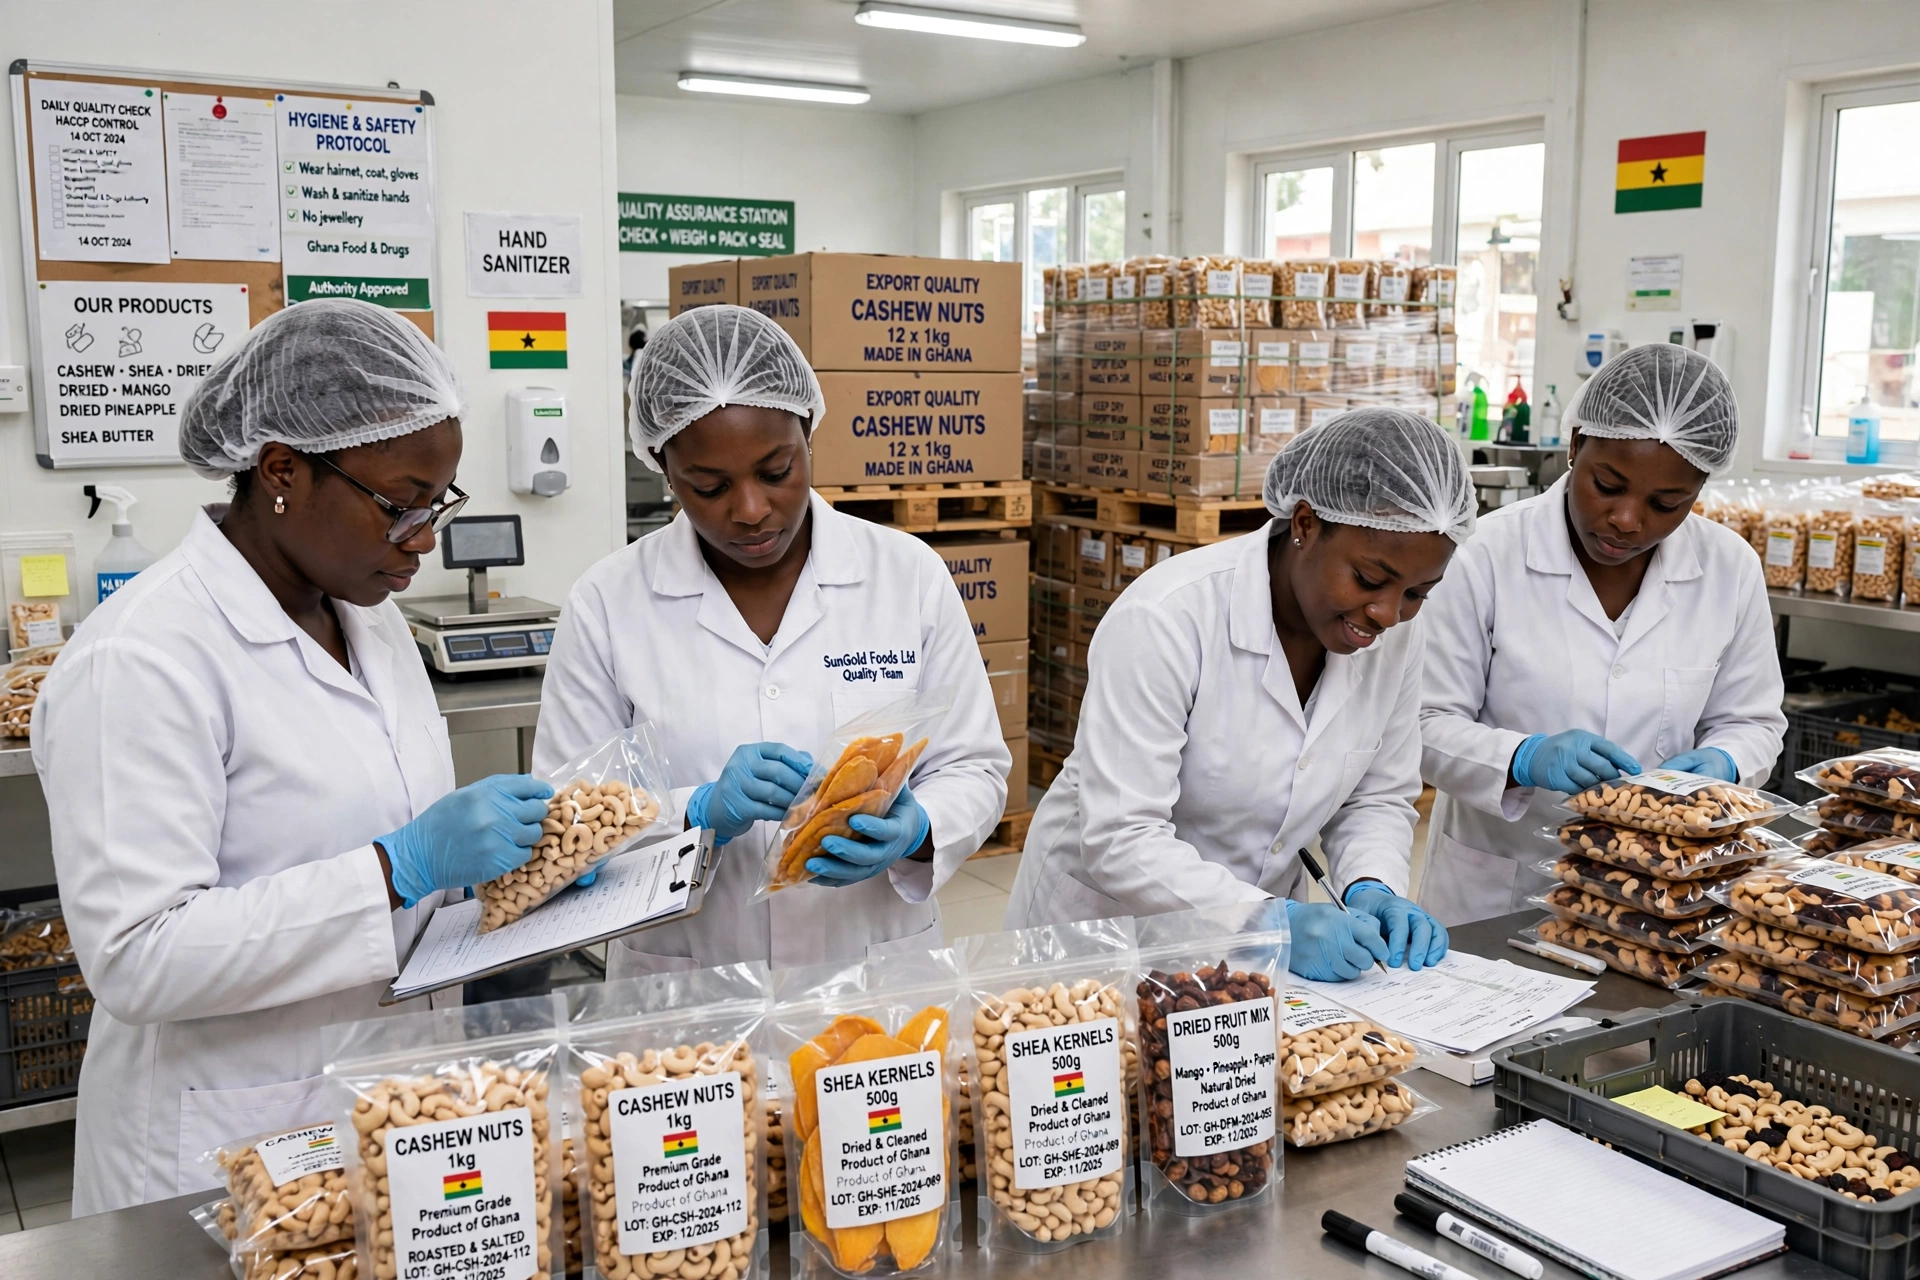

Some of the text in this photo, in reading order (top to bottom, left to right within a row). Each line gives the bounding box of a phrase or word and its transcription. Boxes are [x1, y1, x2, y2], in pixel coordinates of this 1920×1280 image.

[41, 99, 151, 117] DAILY QUALITY CHECK
[56, 115, 139, 130] HACCP CONTROL
[289, 111, 416, 134] HYGIENE & SAFETY
[71, 132, 125, 144] 14 OCT 2024
[316, 134, 390, 154] PROTOCOL
[299, 162, 419, 182] Wear hairnet, coat, gloves
[302, 186, 410, 203] Wash & sanitize hands
[302, 210, 363, 228] No jewellery
[618, 201, 788, 226] UALITY ASSURANCE STATION
[79, 236, 131, 247] 14 OCT 2024
[499, 230, 547, 248] HAND
[619, 226, 786, 249] CHECK WEIGH PACK SEAL
[307, 240, 409, 259] Ghana Food & Drugs
[483, 254, 570, 274] SANITIZER
[308, 281, 409, 298] Authority Approved
[866, 273, 980, 294] EXPORT QUALITY
[74, 297, 213, 314] OUR PRODUCTS
[851, 299, 985, 324] CASHEW NUTS
[888, 327, 950, 347] 12 x 1kg
[864, 347, 972, 363] MADE IN GHANA
[57, 364, 115, 377] CASHEW
[128, 364, 164, 377] SHEA
[122, 384, 171, 396] MANGO
[866, 390, 981, 408] EXPORT QUALITY
[60, 403, 176, 416] DRIED PINEAPPLE
[852, 415, 986, 437] CASHEW NUTS
[61, 429, 154, 444] SHEA BUTTER
[888, 441, 951, 459] 12 x 1kg
[865, 459, 974, 477] MADE IN GHANA
[823, 650, 916, 668] SunGold Foods Ltd
[843, 667, 904, 682] Quality Team
[1173, 1017, 1211, 1037] DRIED
[1215, 1010, 1248, 1031] FRUIT
[1251, 1006, 1270, 1024] MIX
[1012, 1027, 1113, 1058] SHEA KERNELS
[1213, 1033, 1240, 1049] 500g
[1052, 1055, 1081, 1071] 500g
[823, 1061, 935, 1093] SHEA KERNELS
[1175, 1067, 1205, 1081] Mango
[1200, 1073, 1256, 1094] Natural Dried
[618, 1082, 735, 1116] CASHEW NUTS
[866, 1090, 898, 1106] 500g
[1030, 1092, 1109, 1117] Dried & Cleaned
[1192, 1090, 1267, 1112] Product of Ghana
[666, 1113, 692, 1130] 1kg
[1029, 1109, 1111, 1133] Product of Ghana
[1180, 1123, 1202, 1136] LOT:
[265, 1127, 333, 1147] CASHEW
[395, 1119, 524, 1156] CASHEW NUTS
[842, 1128, 927, 1154] Dried & Cleaned
[1204, 1125, 1258, 1147] EXP: 12/2025
[448, 1152, 476, 1170] 1kg
[642, 1153, 722, 1178] Premium Grade
[841, 1146, 930, 1170] Product of Ghana
[1019, 1155, 1042, 1168] LOT:
[1044, 1158, 1103, 1180] EXP: 11/2025
[638, 1168, 729, 1194] Product of Ghana
[419, 1195, 512, 1222] Premium Grade
[632, 1187, 728, 1213] Product of Ghana
[831, 1192, 855, 1206] LOT:
[858, 1194, 921, 1217] EXP: 11/2025
[624, 1199, 742, 1232] LOT: GH-CSH-2024-112
[412, 1211, 521, 1241] Product of Ghana
[652, 1220, 719, 1244] EXP: 12/2025
[408, 1230, 525, 1263] ROASTED & SALTED
[404, 1244, 531, 1280] LOT: GH-CSH-2024-112
